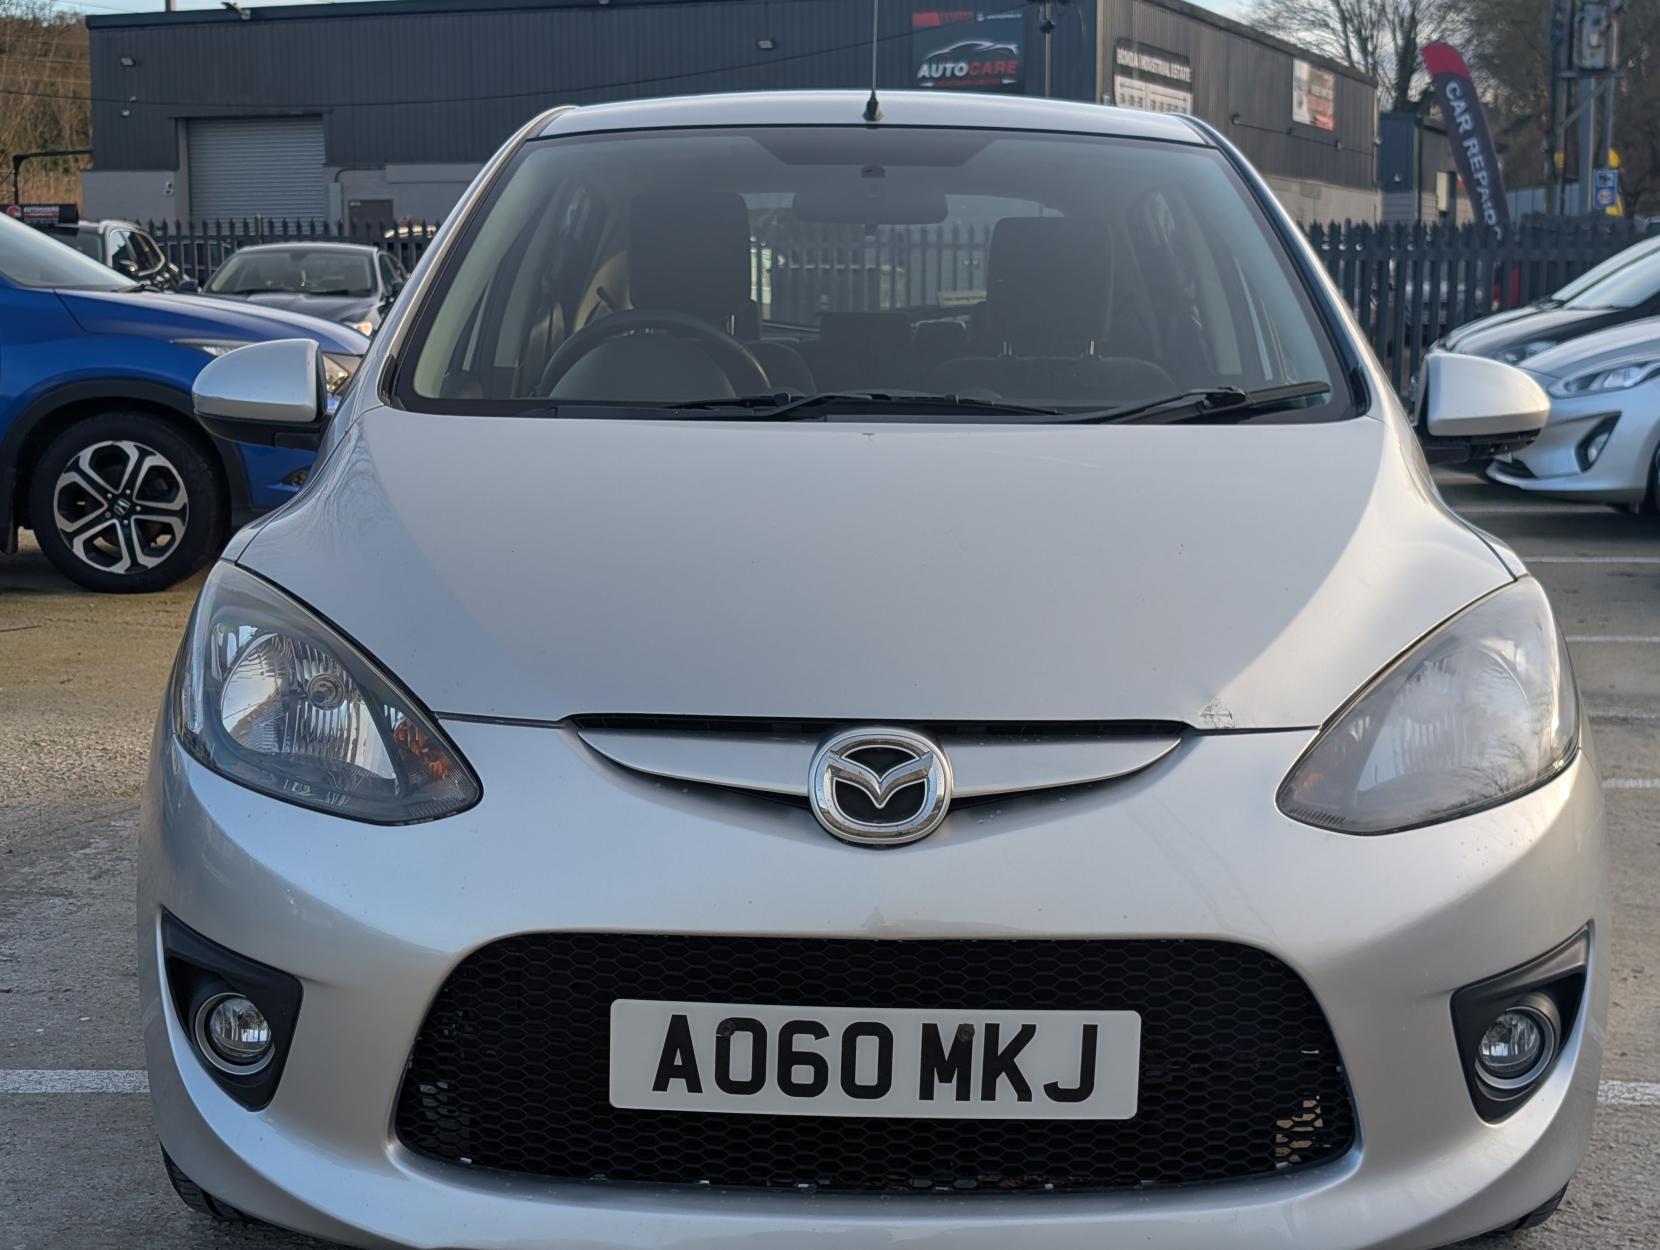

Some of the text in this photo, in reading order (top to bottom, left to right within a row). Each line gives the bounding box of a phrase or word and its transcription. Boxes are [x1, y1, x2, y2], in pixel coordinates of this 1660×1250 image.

[917, 60, 1018, 79] AUTOCARE
[1446, 80, 1473, 134] CAR
[652, 1014, 1099, 1103] AO60 MKJ
